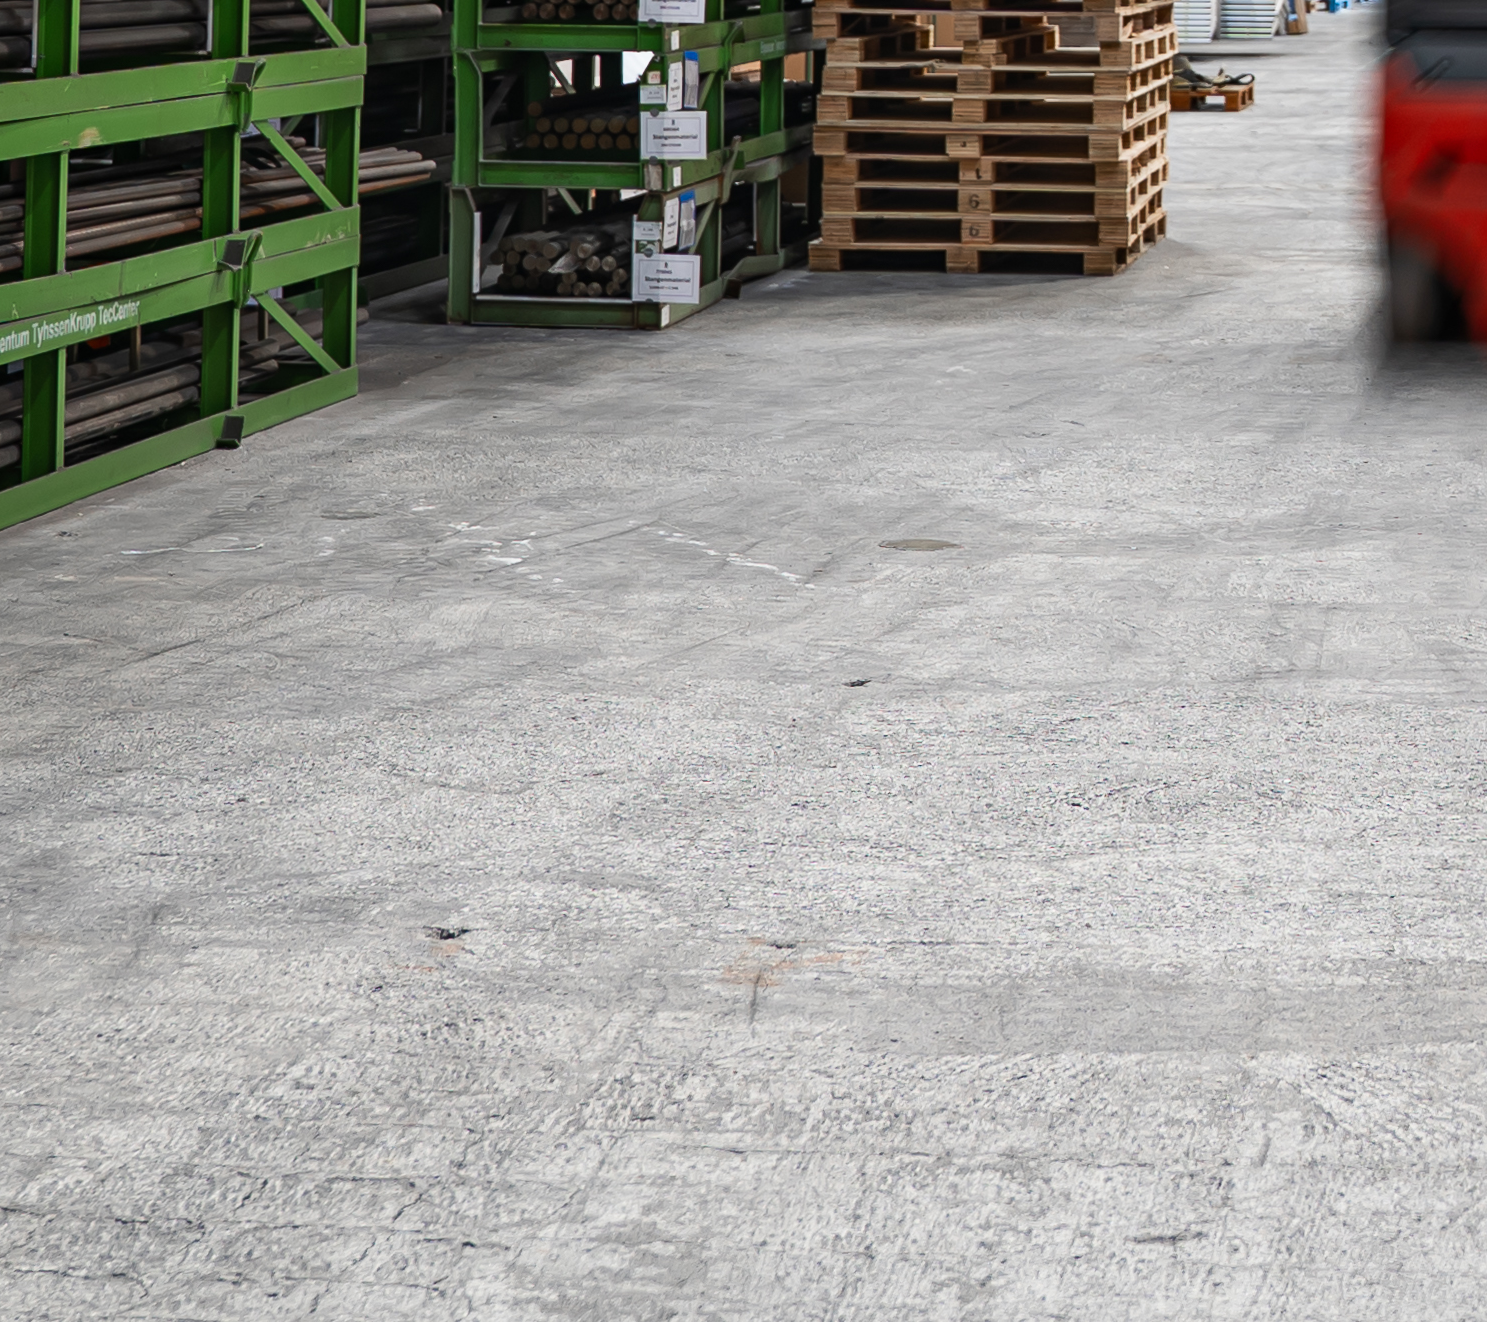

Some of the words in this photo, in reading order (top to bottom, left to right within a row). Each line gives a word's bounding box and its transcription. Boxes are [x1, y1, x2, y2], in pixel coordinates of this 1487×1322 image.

[652, 133, 699, 141] Stangenmaterial
[644, 275, 692, 284] Stangenmaterial
[31, 310, 97, 349] TyhssenKrupp
[97, 299, 141, 327] TecCenter
